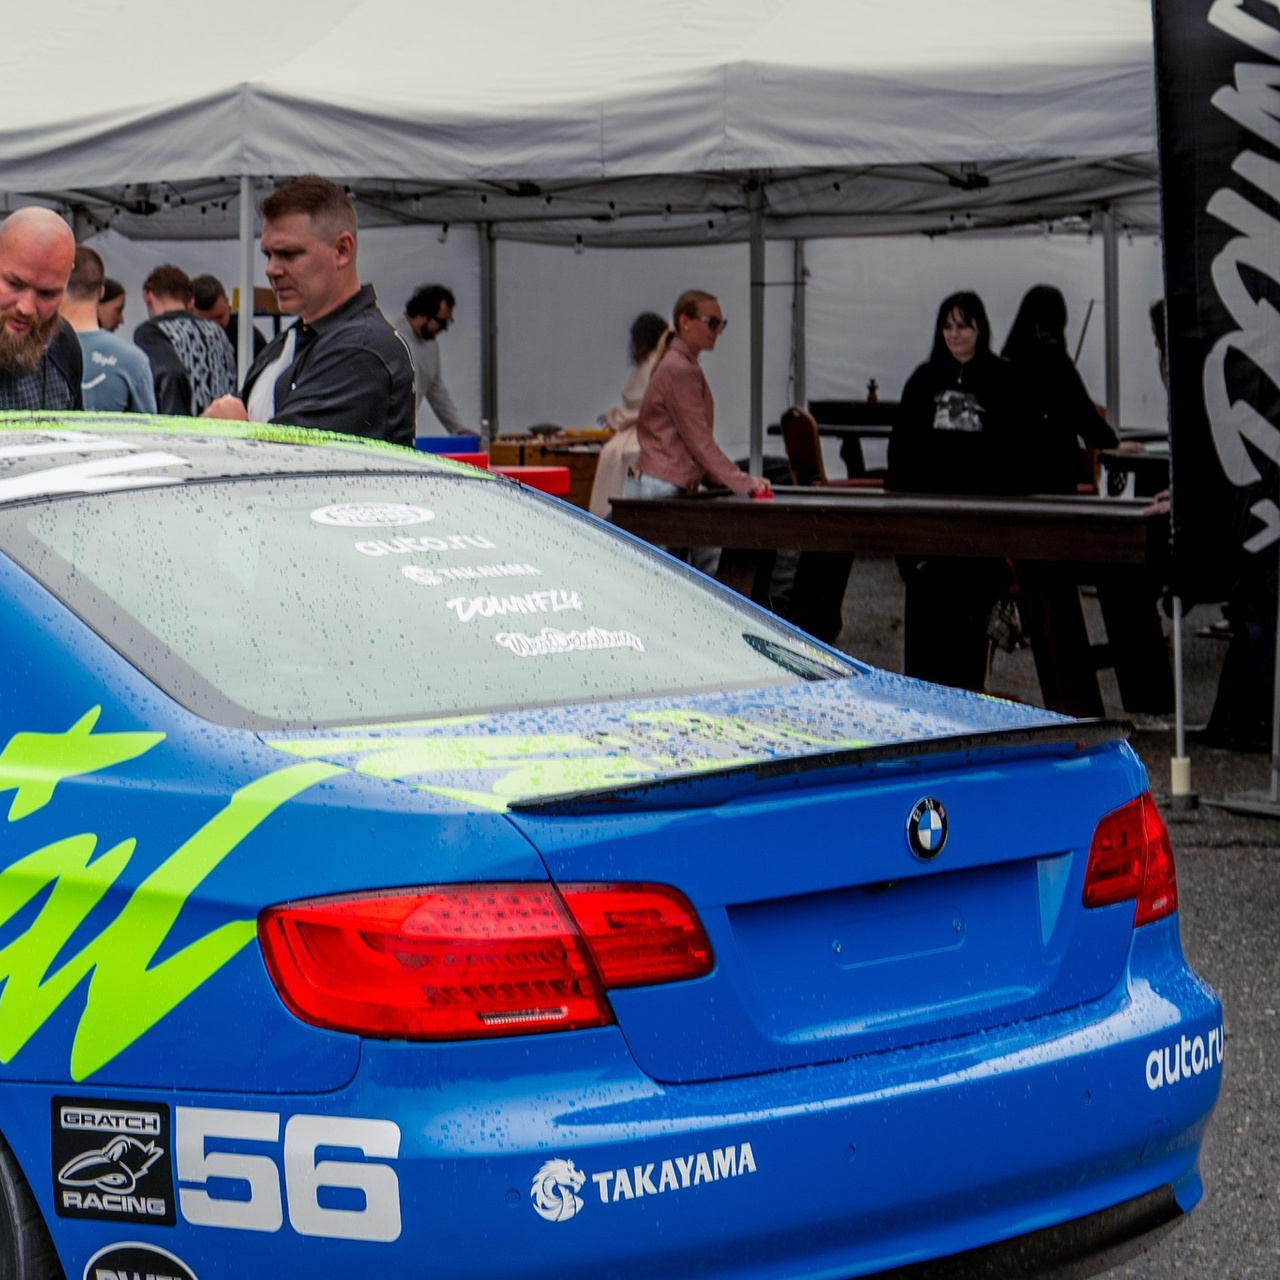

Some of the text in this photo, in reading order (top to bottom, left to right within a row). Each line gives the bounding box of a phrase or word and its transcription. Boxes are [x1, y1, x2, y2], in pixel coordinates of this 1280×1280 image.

[355, 534, 497, 556] auto.ru
[1145, 1024, 1224, 1091] auto.ru
[62, 1110, 160, 1133] GRATCH
[175, 1106, 402, 1243] 56
[592, 1142, 757, 1204] TAKAYAMA
[62, 1191, 166, 1216] RACING
